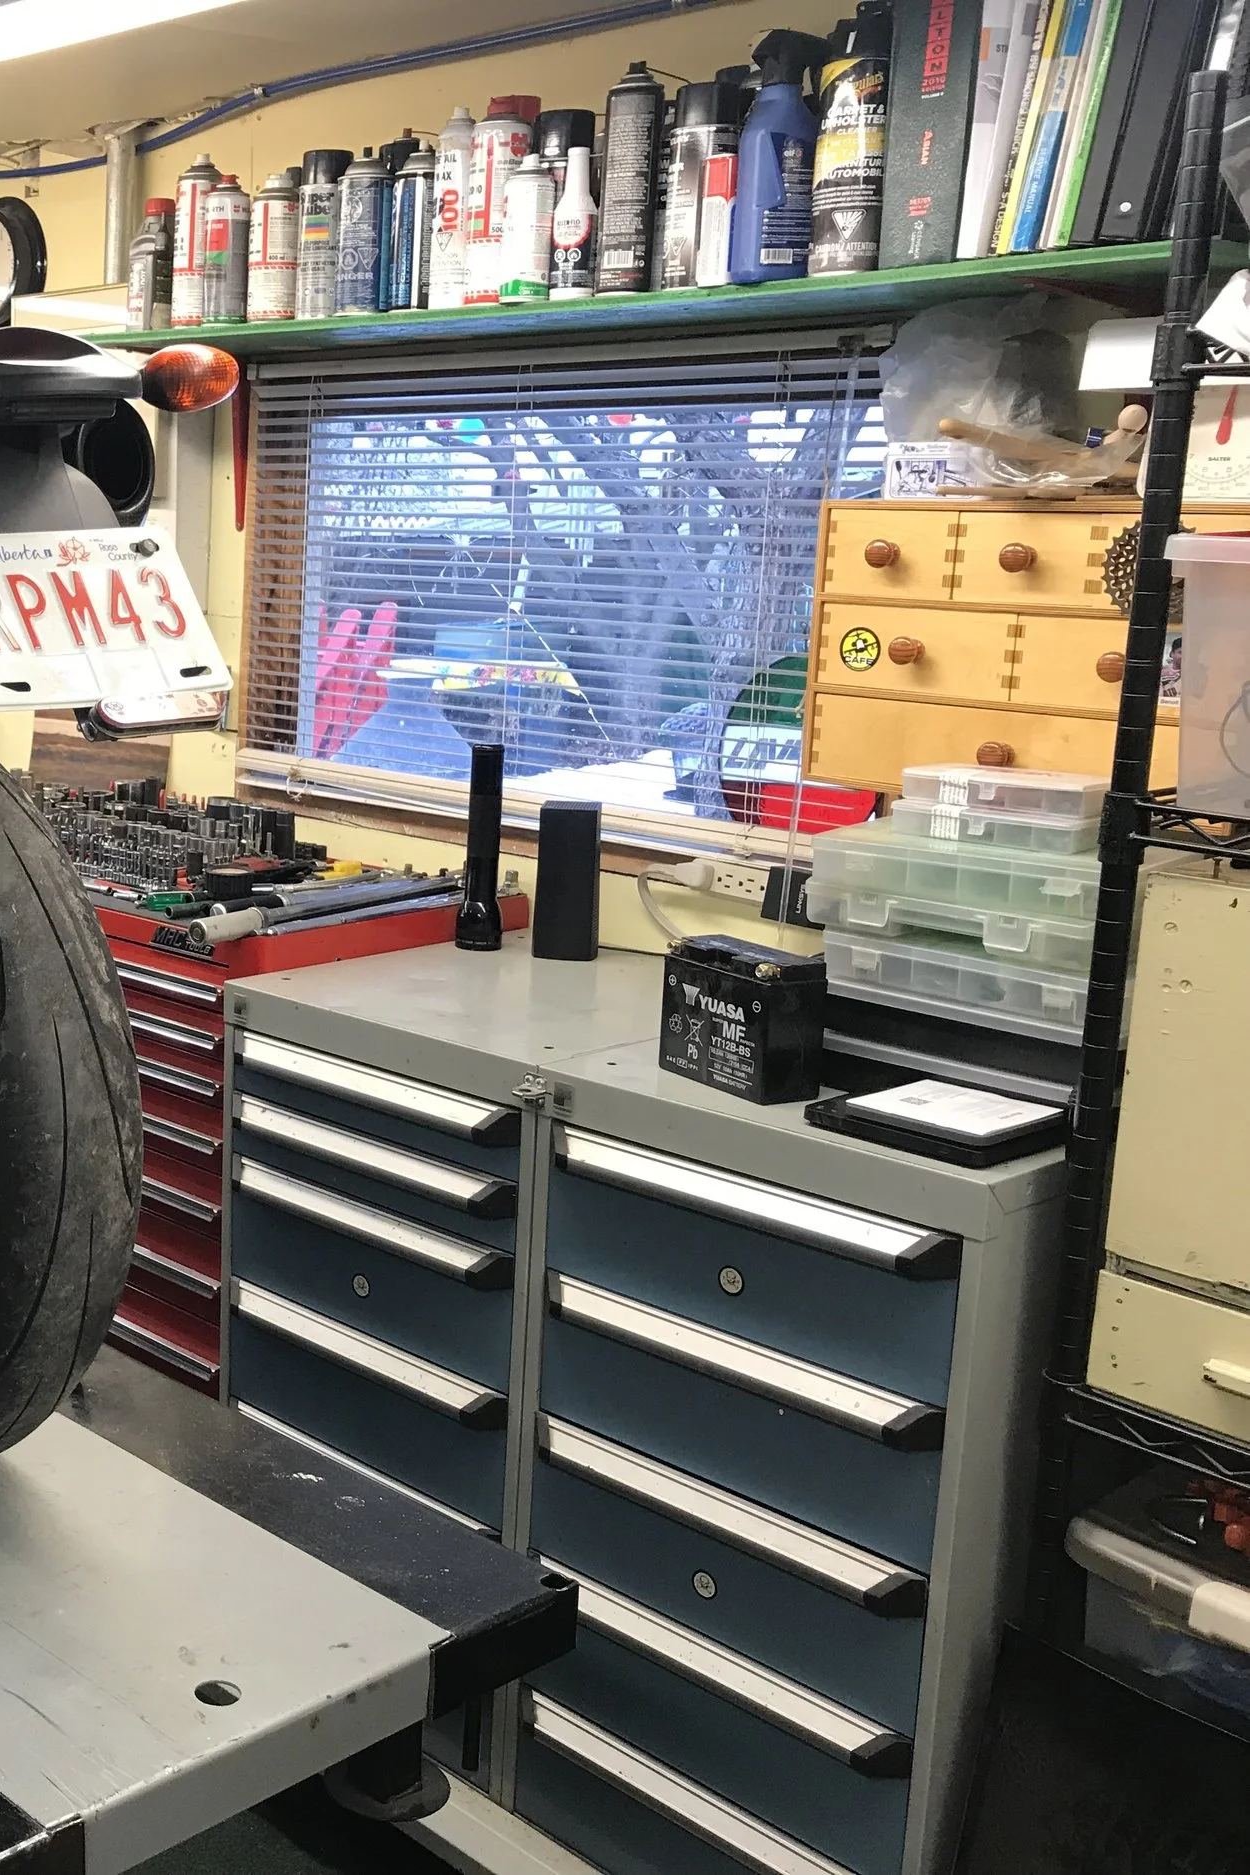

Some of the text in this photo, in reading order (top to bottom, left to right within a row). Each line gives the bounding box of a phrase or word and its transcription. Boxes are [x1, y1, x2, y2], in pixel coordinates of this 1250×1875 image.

[783, 149, 796, 157] elf
[920, 130, 933, 166] ASIAN
[1024, 180, 1039, 214] MANUAL
[844, 655, 875, 665] CAFE
[155, 927, 212, 954] MAC TOOLS
[699, 994, 746, 1023] YUASA
[722, 1020, 747, 1042] MF
[687, 1043, 699, 1060] Pb
[710, 1035, 751, 1058] YT12B-BS
